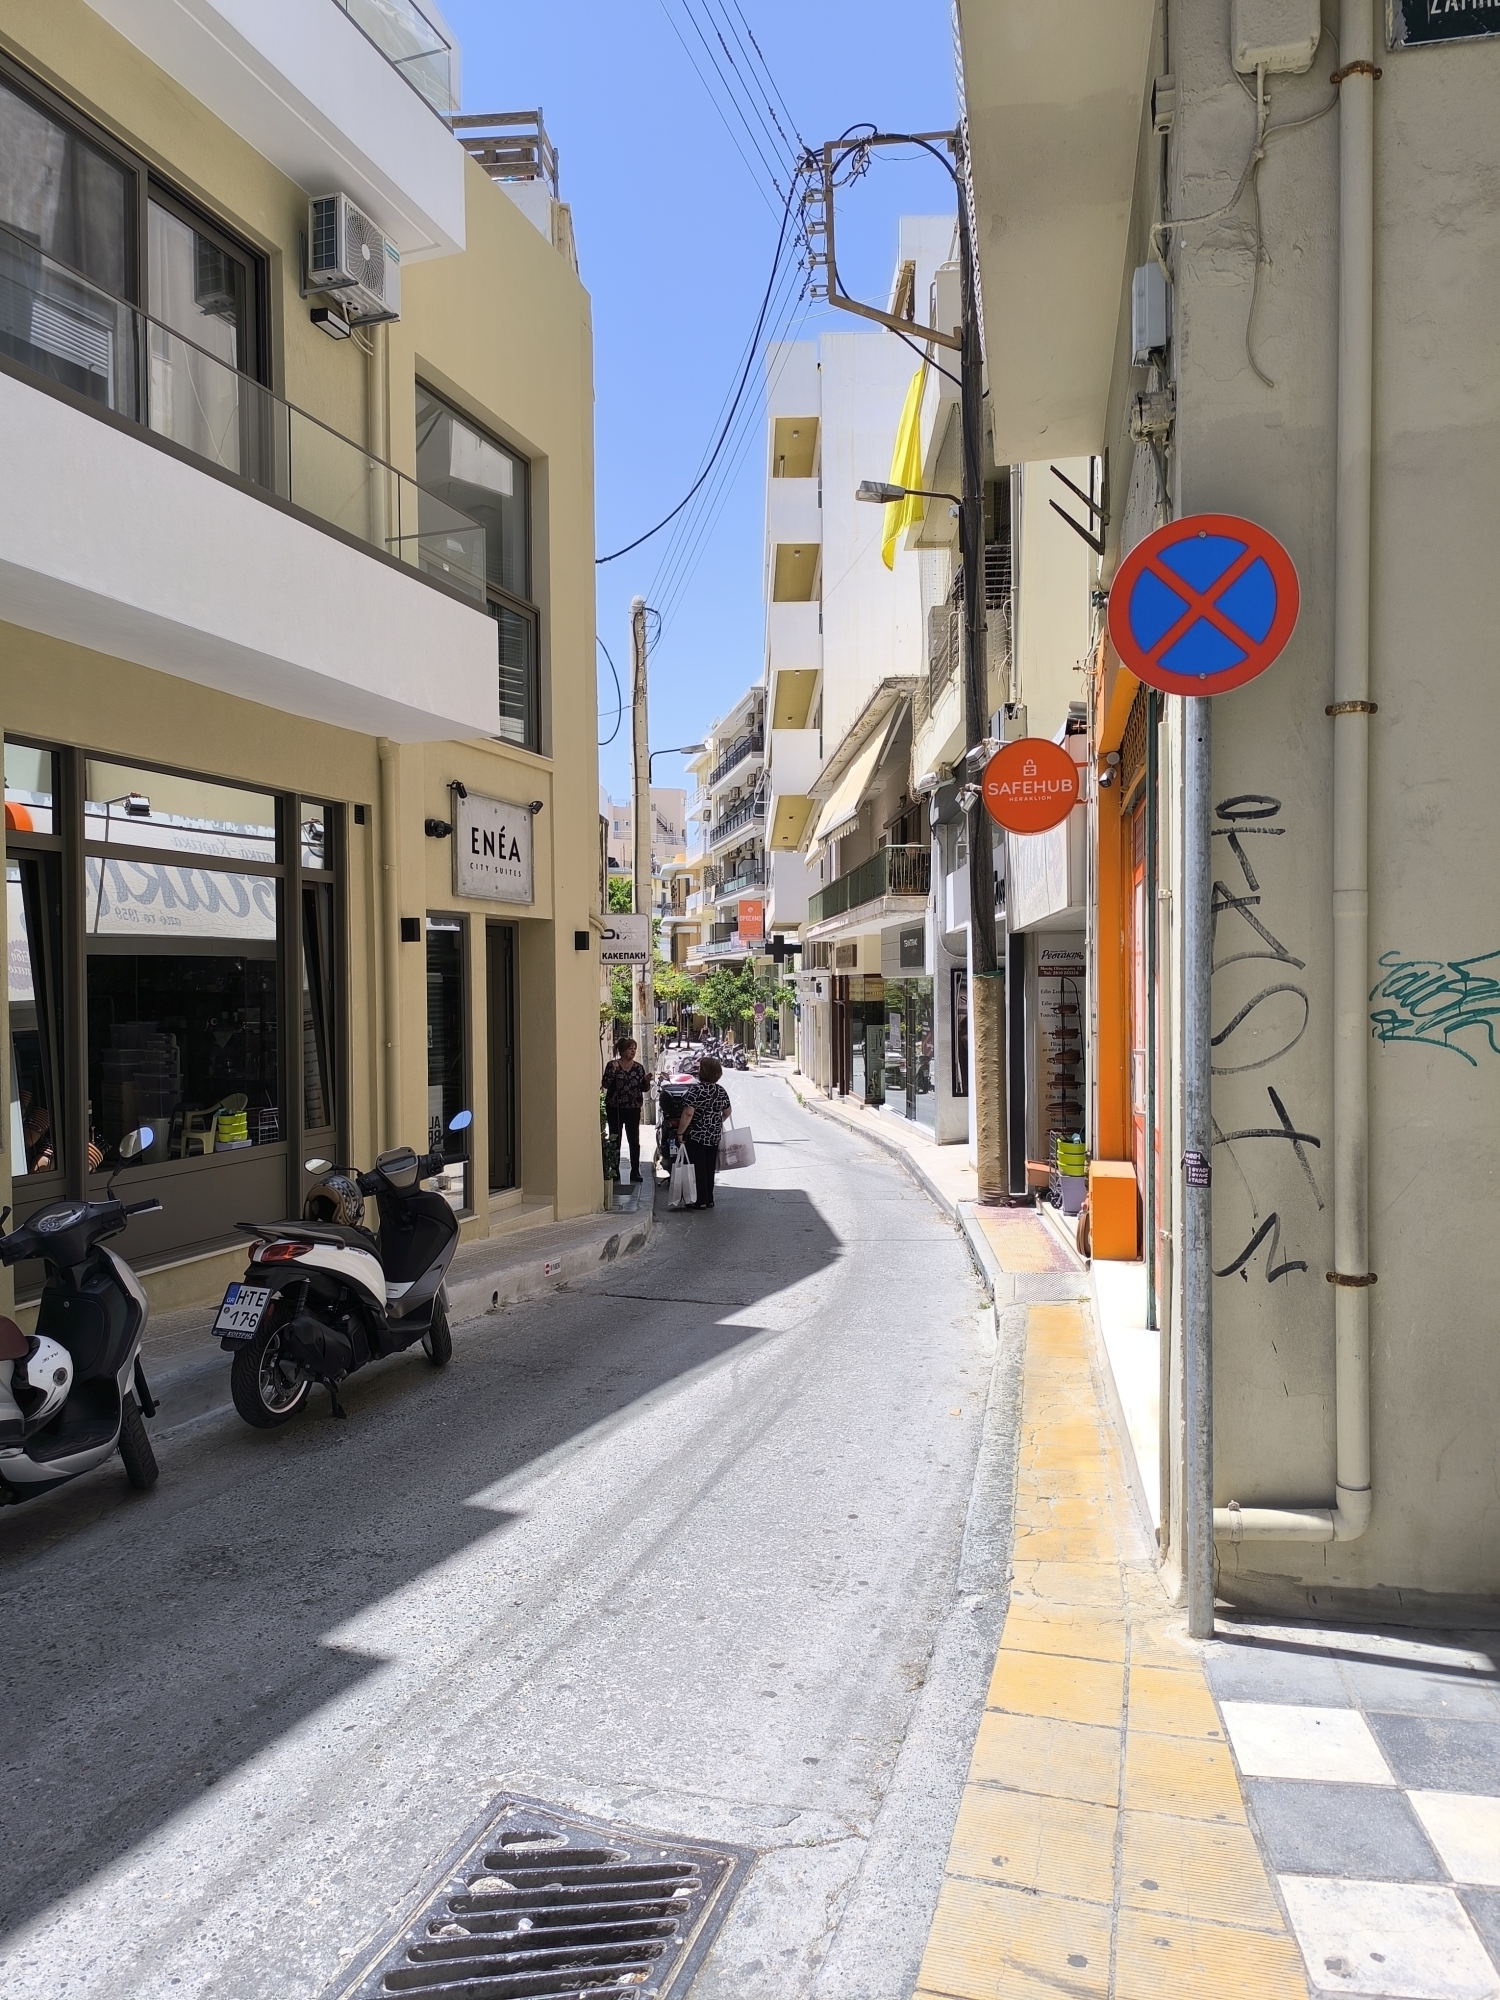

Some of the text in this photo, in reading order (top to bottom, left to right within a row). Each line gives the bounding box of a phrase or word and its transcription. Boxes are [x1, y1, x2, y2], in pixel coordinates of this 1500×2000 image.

[988, 779, 1073, 796] SAFEHUB
[471, 825, 521, 862] ENÉA
[470, 862, 522, 877] CITY SUITES
[602, 952, 646, 960] ΚΑΚΕΠΑΚΗ
[230, 1310, 259, 1328] 176
